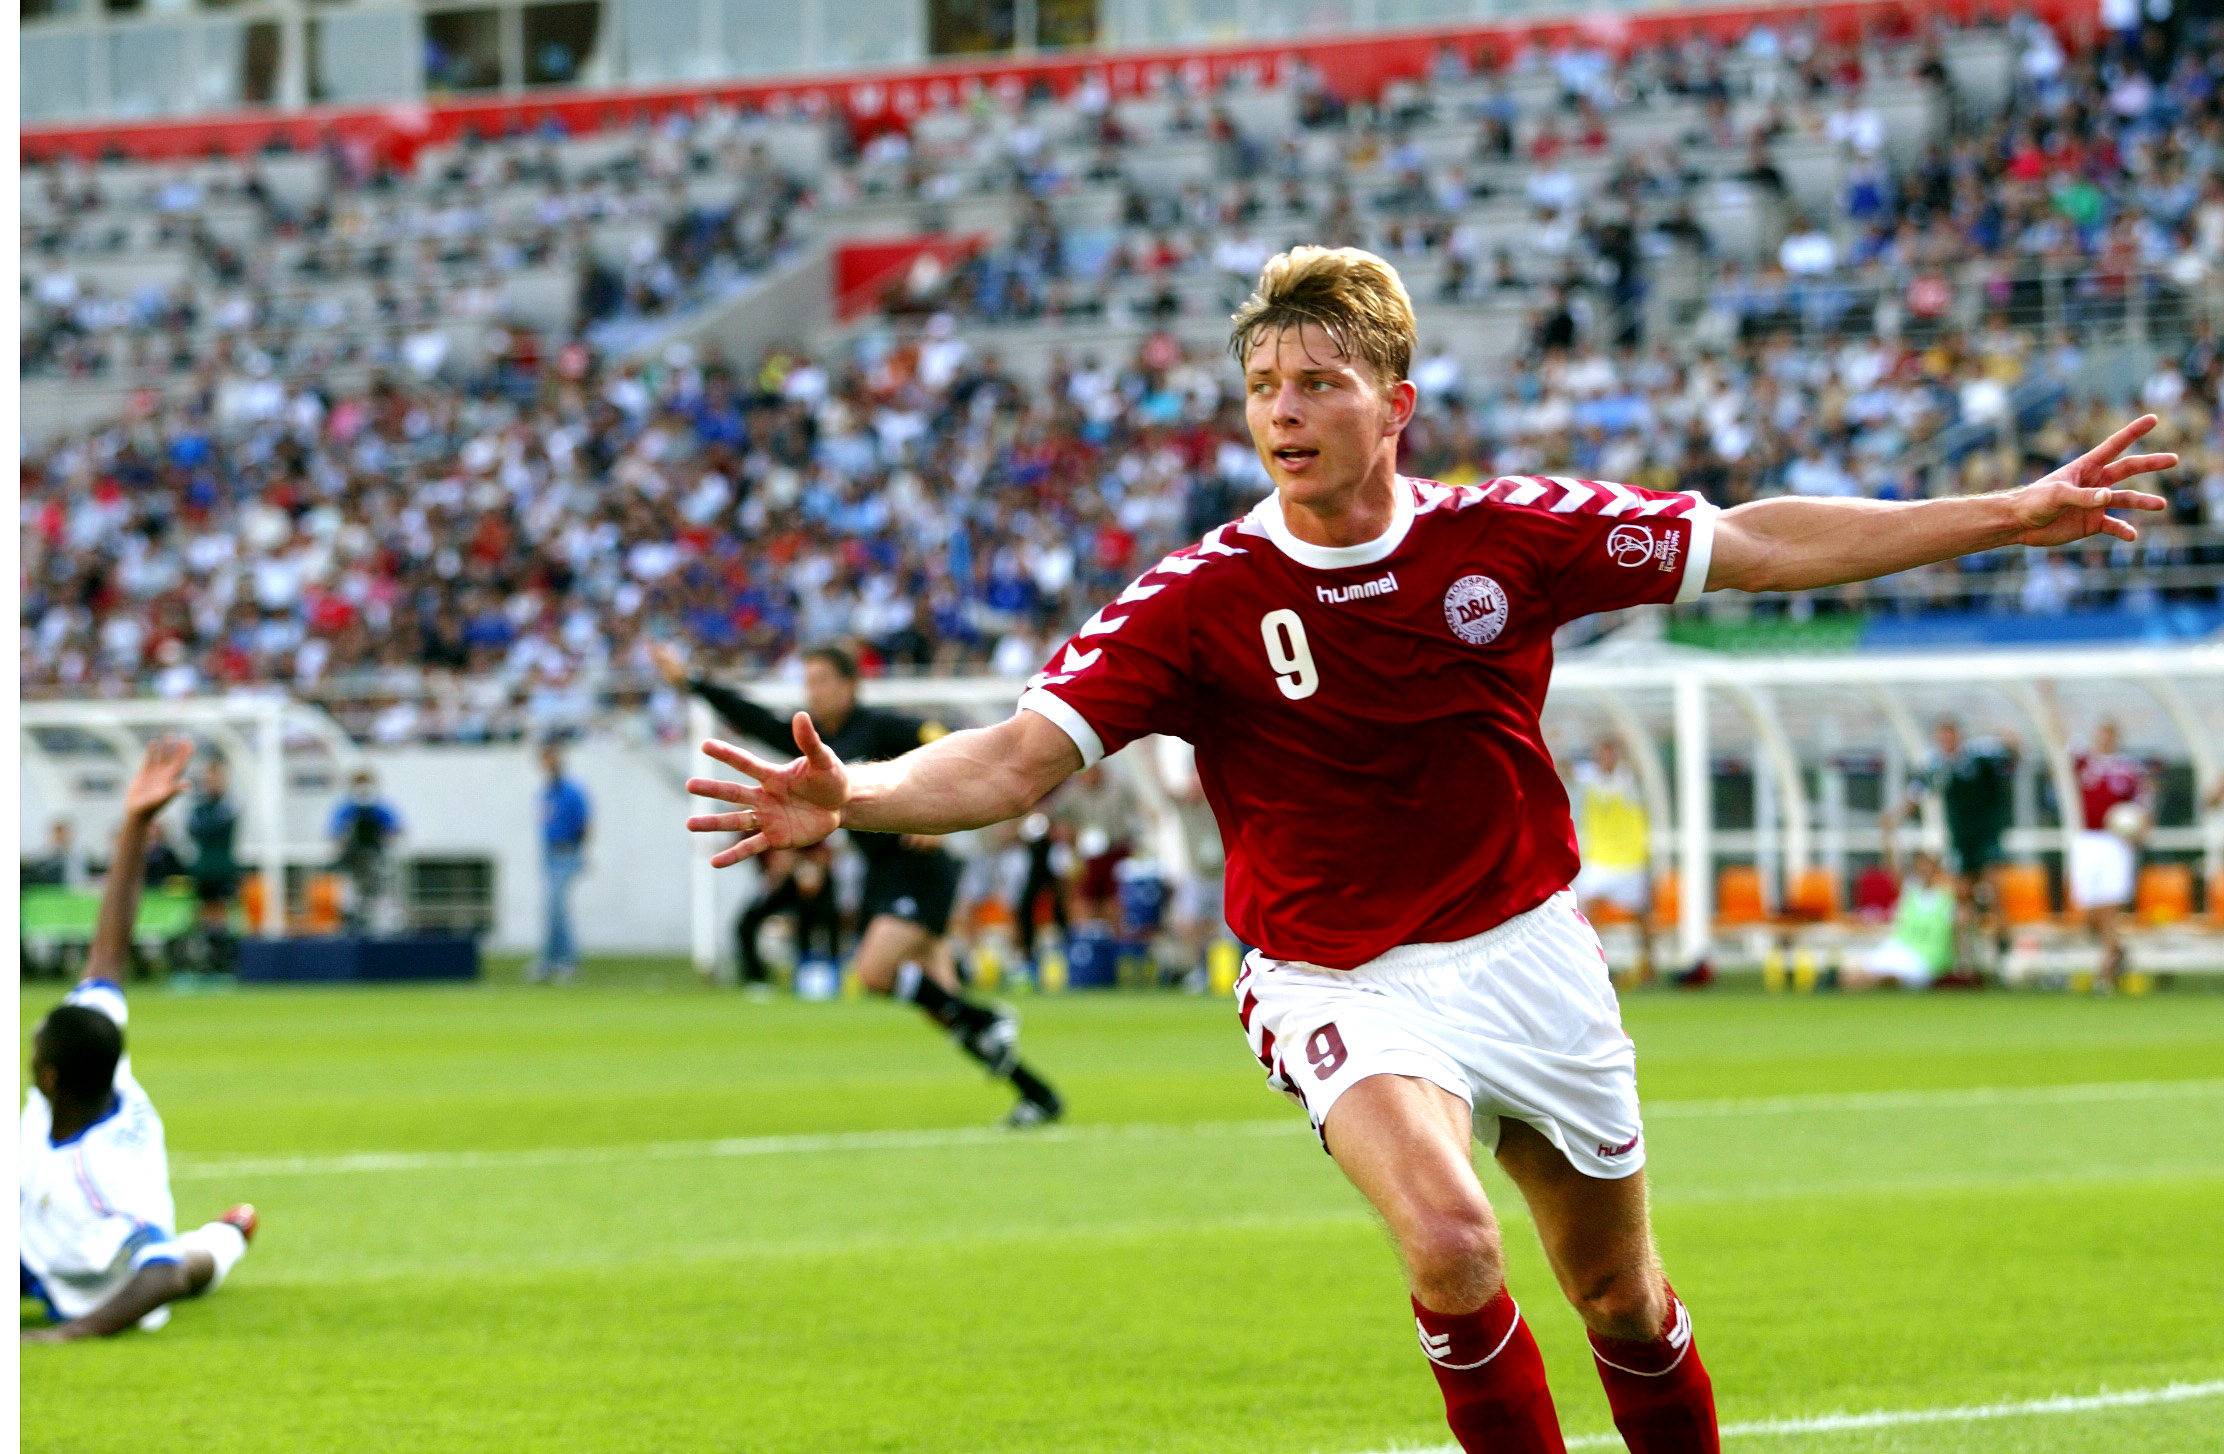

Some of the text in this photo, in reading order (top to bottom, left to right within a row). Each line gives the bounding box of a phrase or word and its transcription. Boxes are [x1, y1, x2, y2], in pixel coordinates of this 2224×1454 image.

[1316, 571, 1399, 604] hummel
[1456, 594, 1496, 625] DBU
[1261, 609, 1319, 700] 9
[1306, 1022, 1348, 1080] 9
